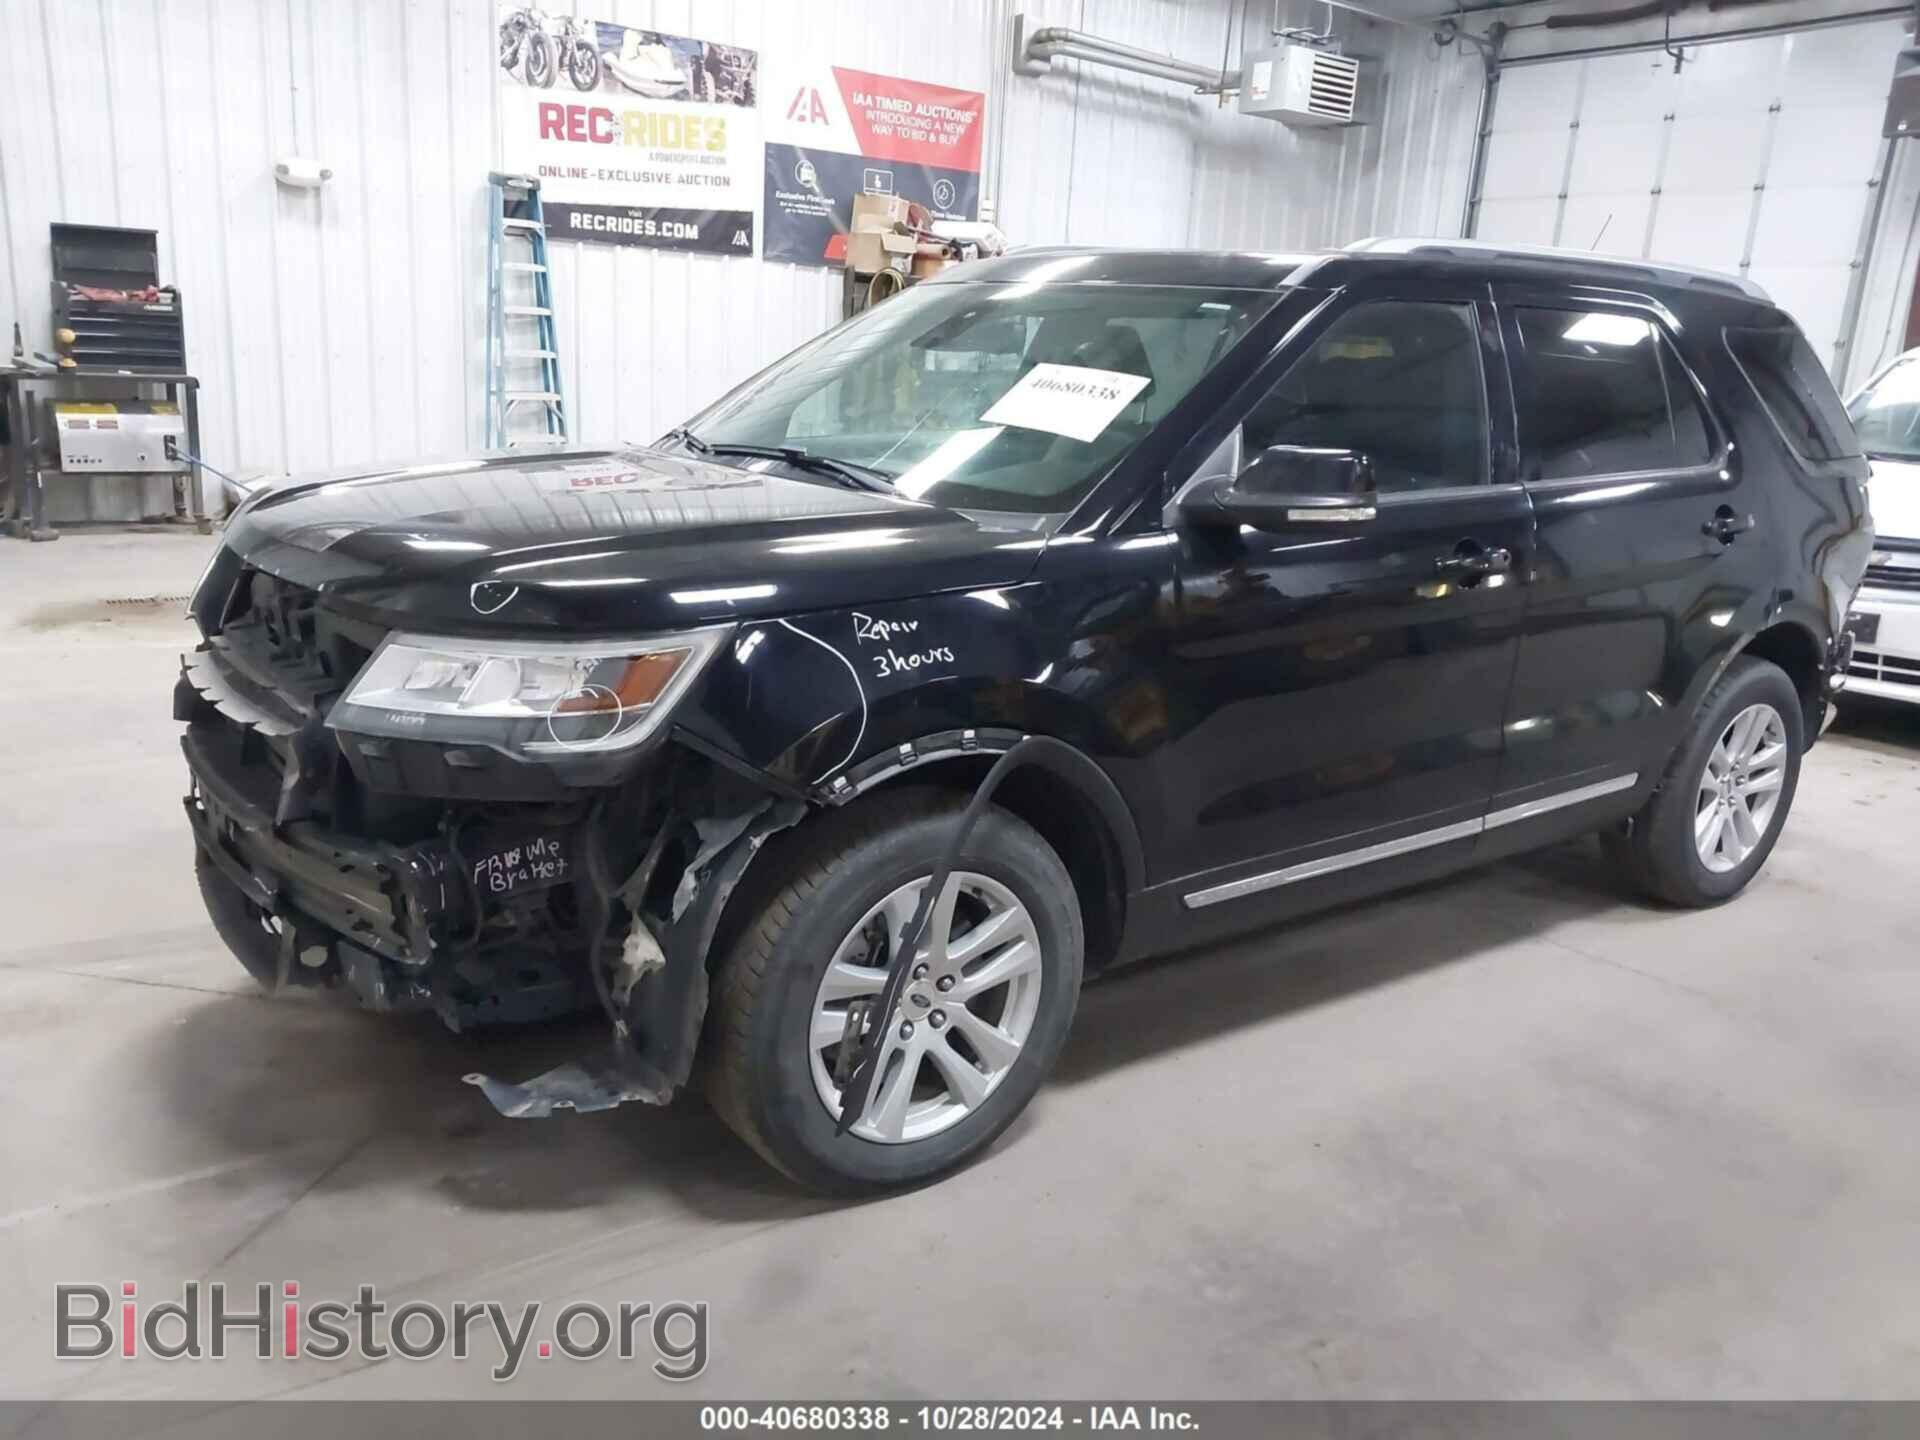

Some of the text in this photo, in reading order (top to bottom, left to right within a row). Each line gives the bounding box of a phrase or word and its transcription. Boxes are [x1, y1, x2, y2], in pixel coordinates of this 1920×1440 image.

[852, 92, 873, 107] IAA
[875, 95, 913, 113] TIMED
[538, 102, 727, 152] REC RIDES
[865, 110, 966, 135] INTRODUCING A NEW
[871, 124, 894, 137] WAY
[896, 126, 910, 138] TO
[911, 130, 926, 142] BID
[939, 133, 959, 145] BUY
[538, 164, 731, 187] ONLINE-EXCLUSIVE AUCTION
[570, 211, 699, 240] RECRIDES.COM
